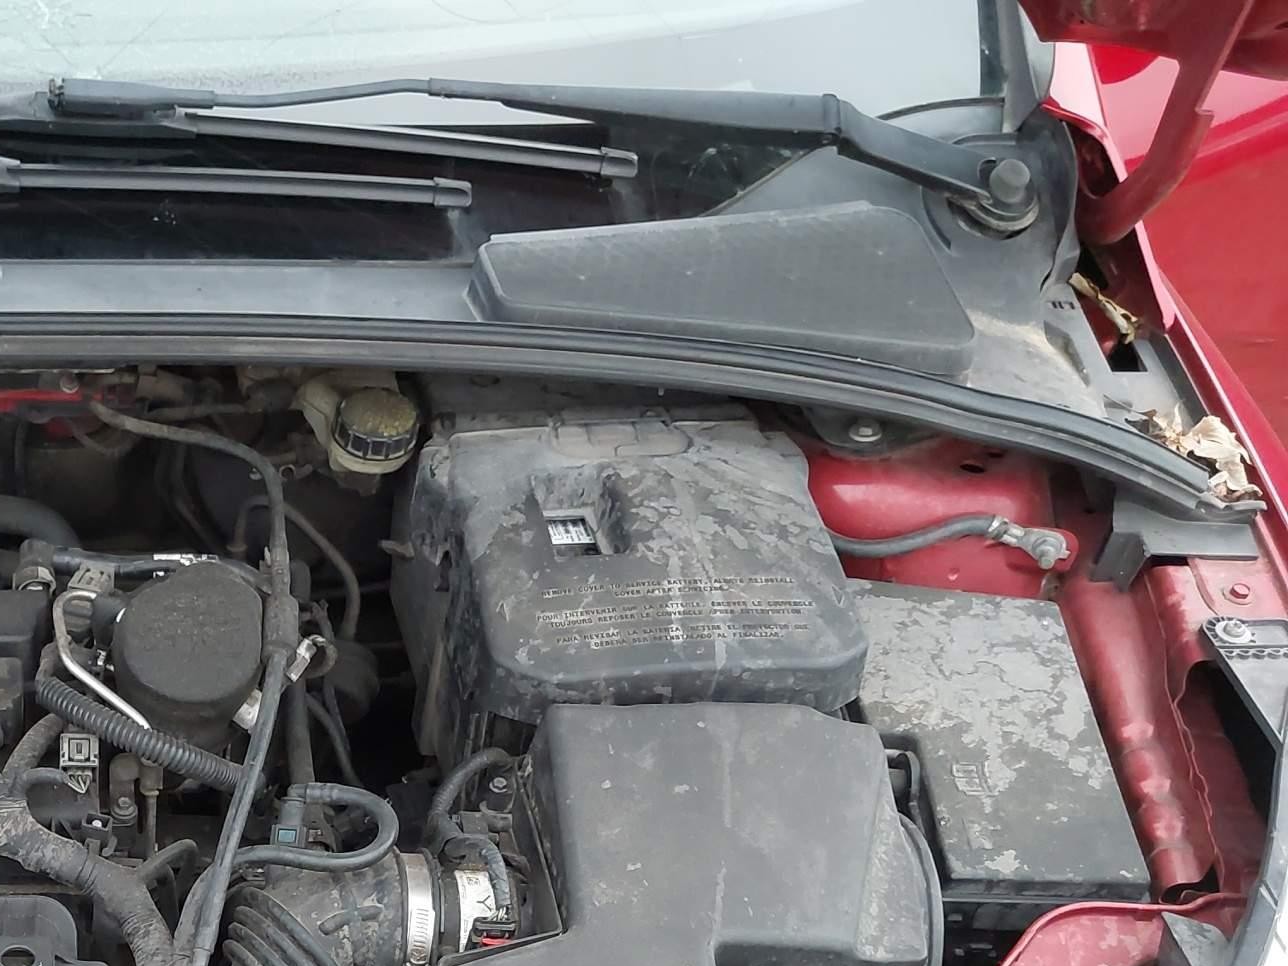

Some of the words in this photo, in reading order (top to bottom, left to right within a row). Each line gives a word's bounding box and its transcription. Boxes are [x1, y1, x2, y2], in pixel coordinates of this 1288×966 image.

[578, 584, 603, 592] COVER
[537, 613, 559, 622] POUR
[550, 618, 593, 628] TOUJOURS
